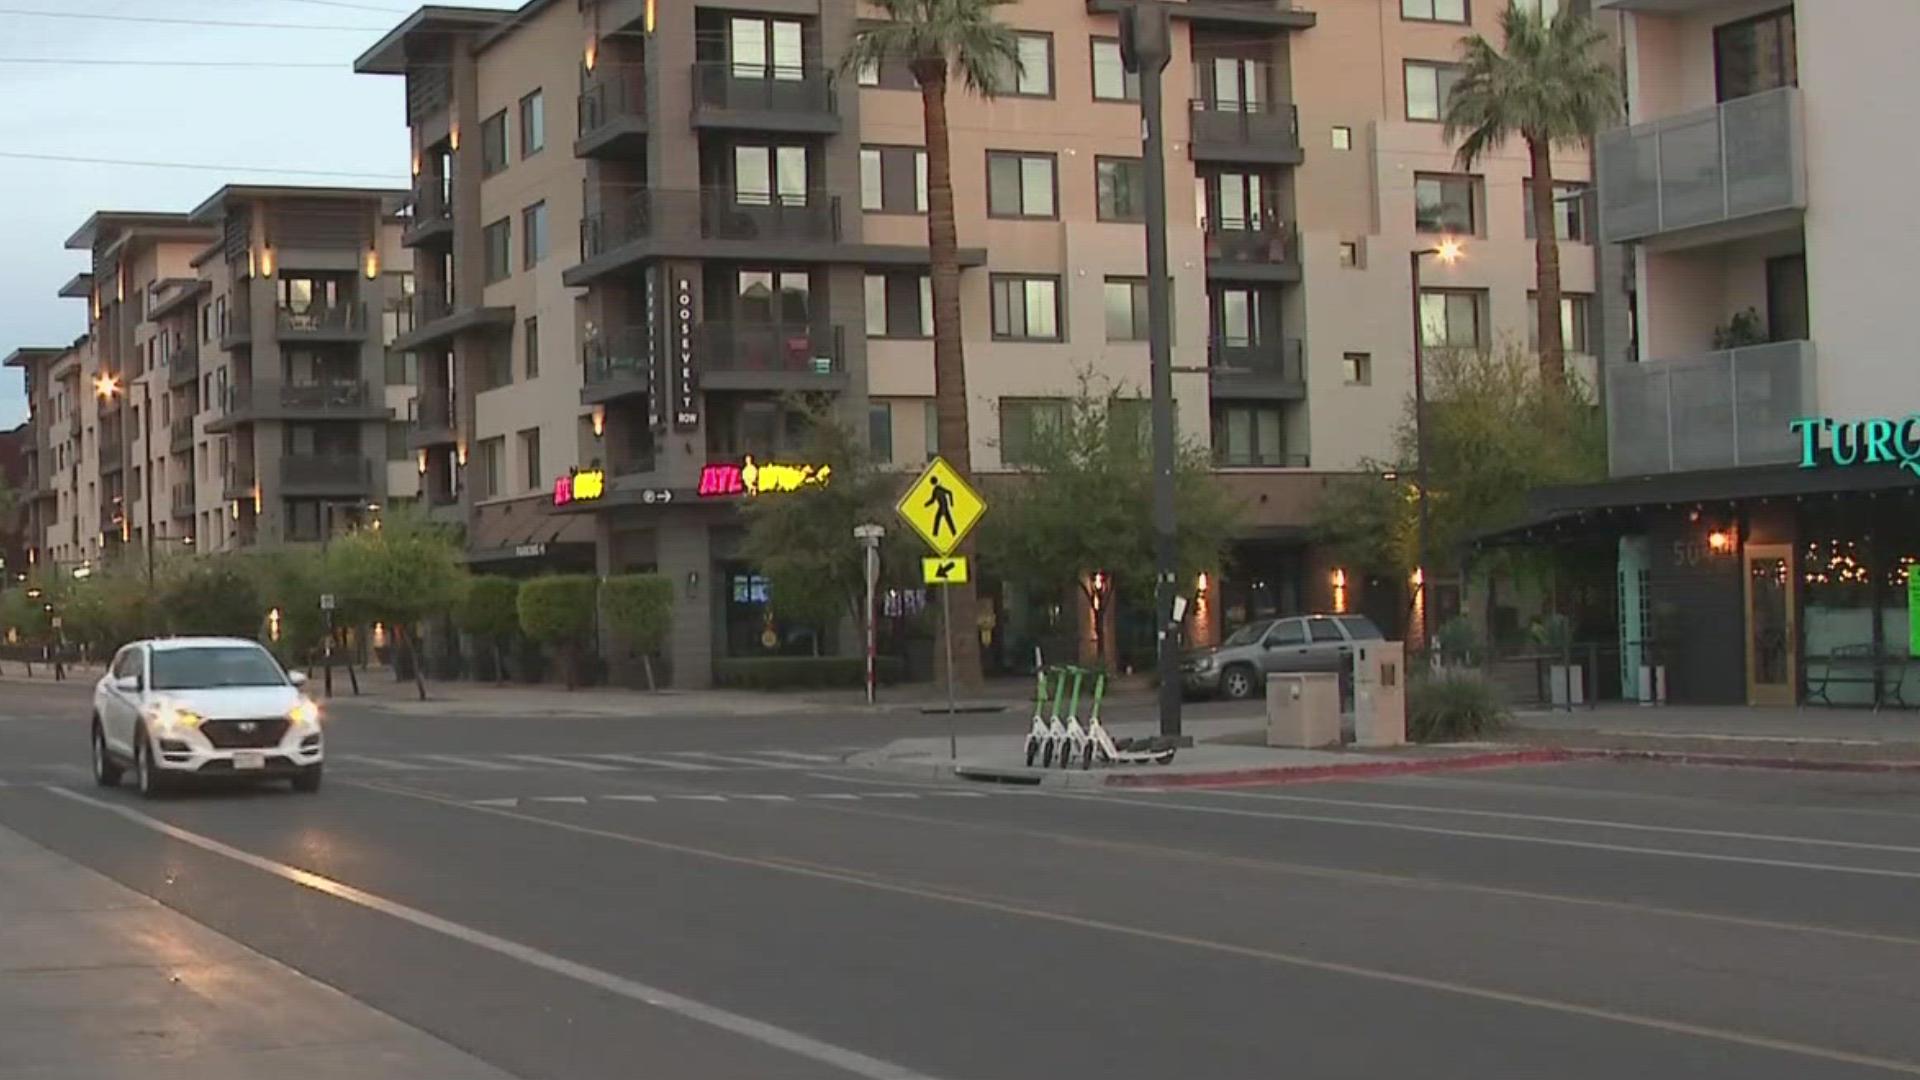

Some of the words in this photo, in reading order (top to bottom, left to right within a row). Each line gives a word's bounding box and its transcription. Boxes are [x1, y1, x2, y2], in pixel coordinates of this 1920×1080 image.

[679, 279, 692, 407] ROOSEVELT
[678, 412, 697, 424] ROW
[699, 464, 743, 495] ATL
